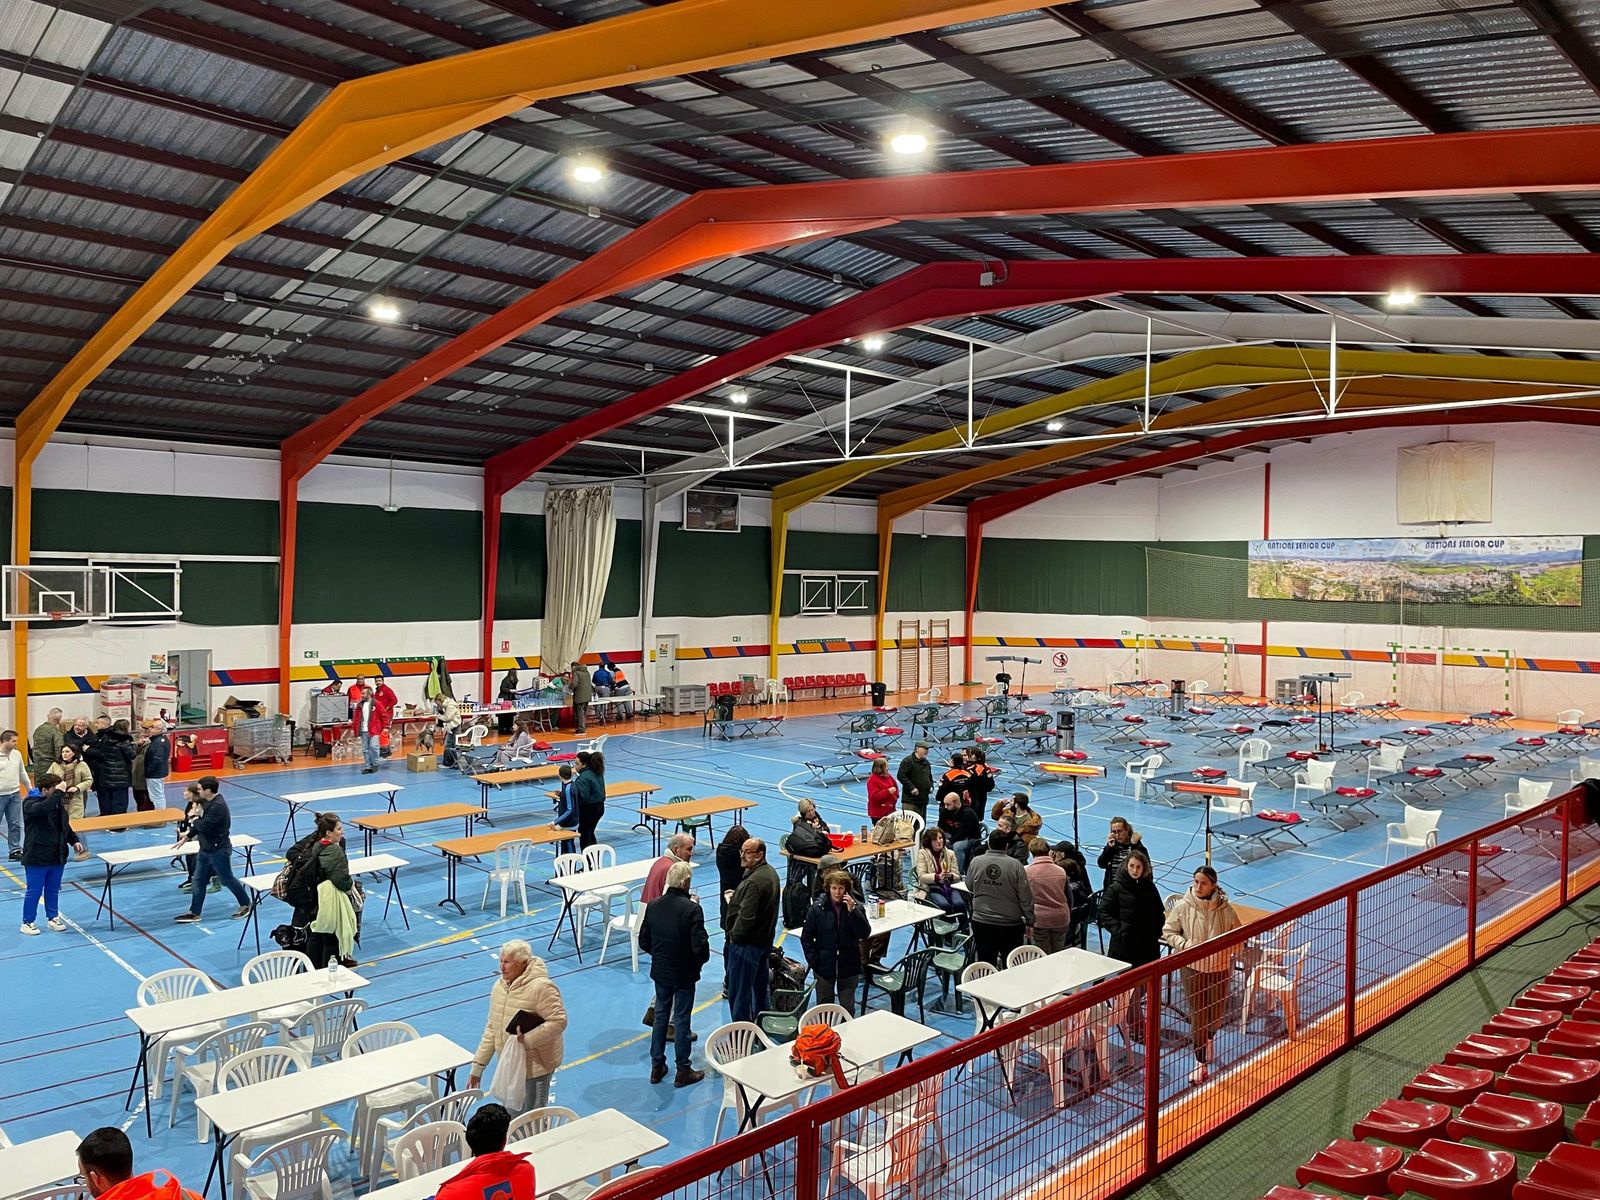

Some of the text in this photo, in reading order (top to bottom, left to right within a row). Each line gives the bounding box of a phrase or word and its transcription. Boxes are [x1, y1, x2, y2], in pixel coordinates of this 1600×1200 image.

[1267, 542, 1294, 550] NATIONS
[1425, 540, 1457, 549] NATIONS
[1459, 540, 1485, 548] SENIOR
[1487, 540, 1505, 548] CUP
